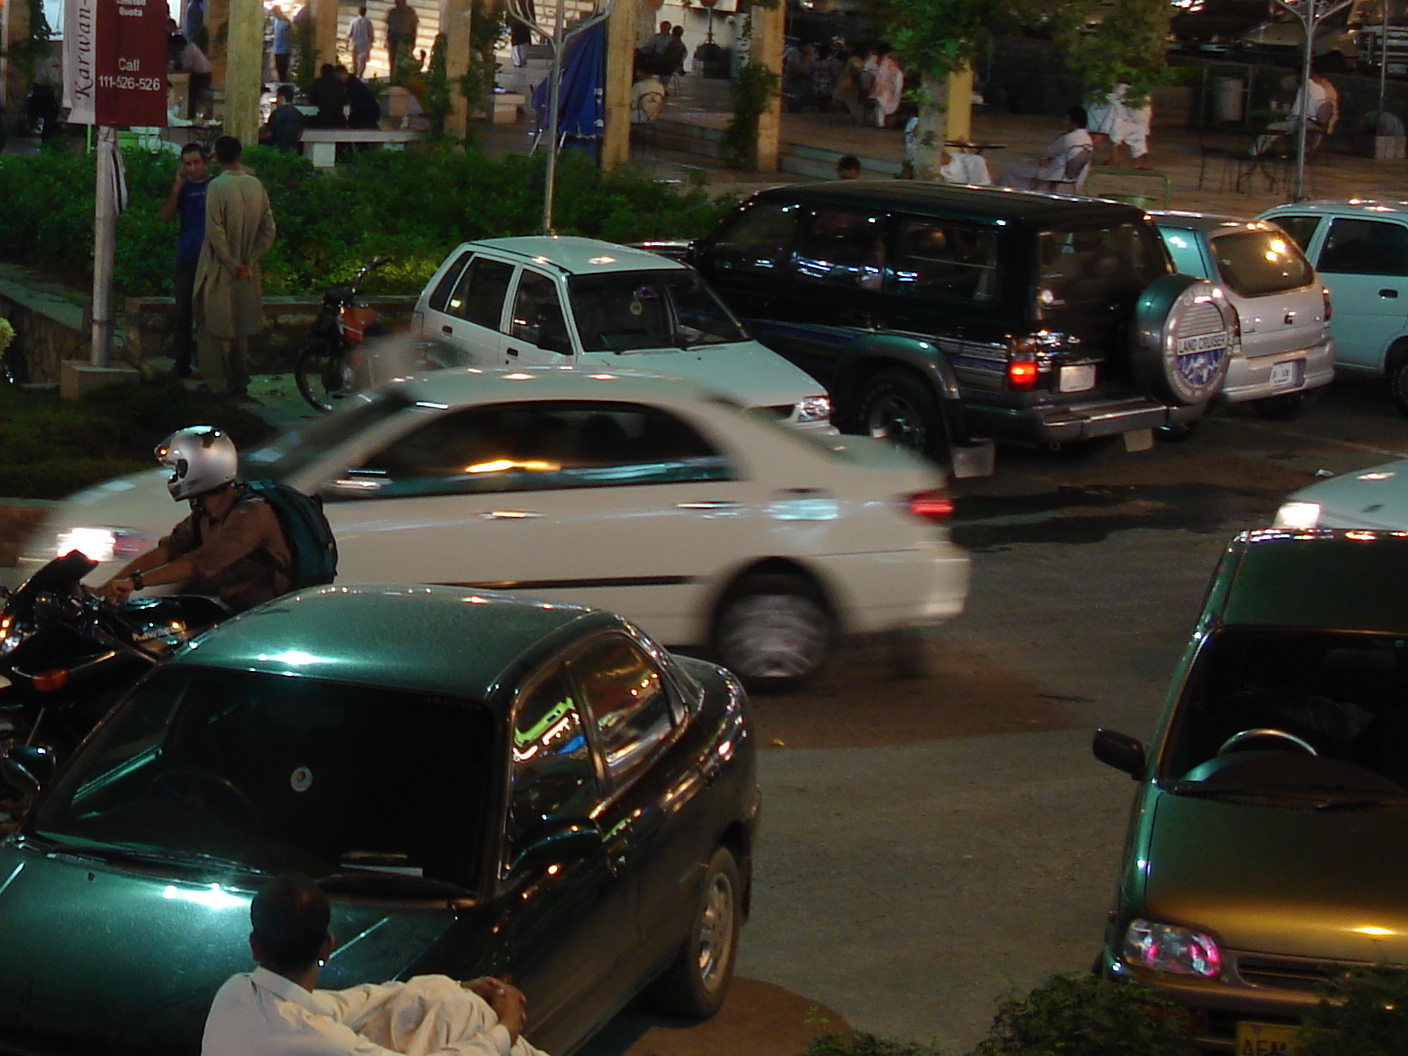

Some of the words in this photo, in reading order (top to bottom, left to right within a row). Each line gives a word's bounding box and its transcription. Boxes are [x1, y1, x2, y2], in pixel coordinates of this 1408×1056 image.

[118, 6, 143, 17] Quota
[118, 57, 140, 71] Call
[99, 75, 161, 91] 111-526-526
[1178, 339, 1197, 354] LAND
[1198, 334, 1226, 350] CRUISER
